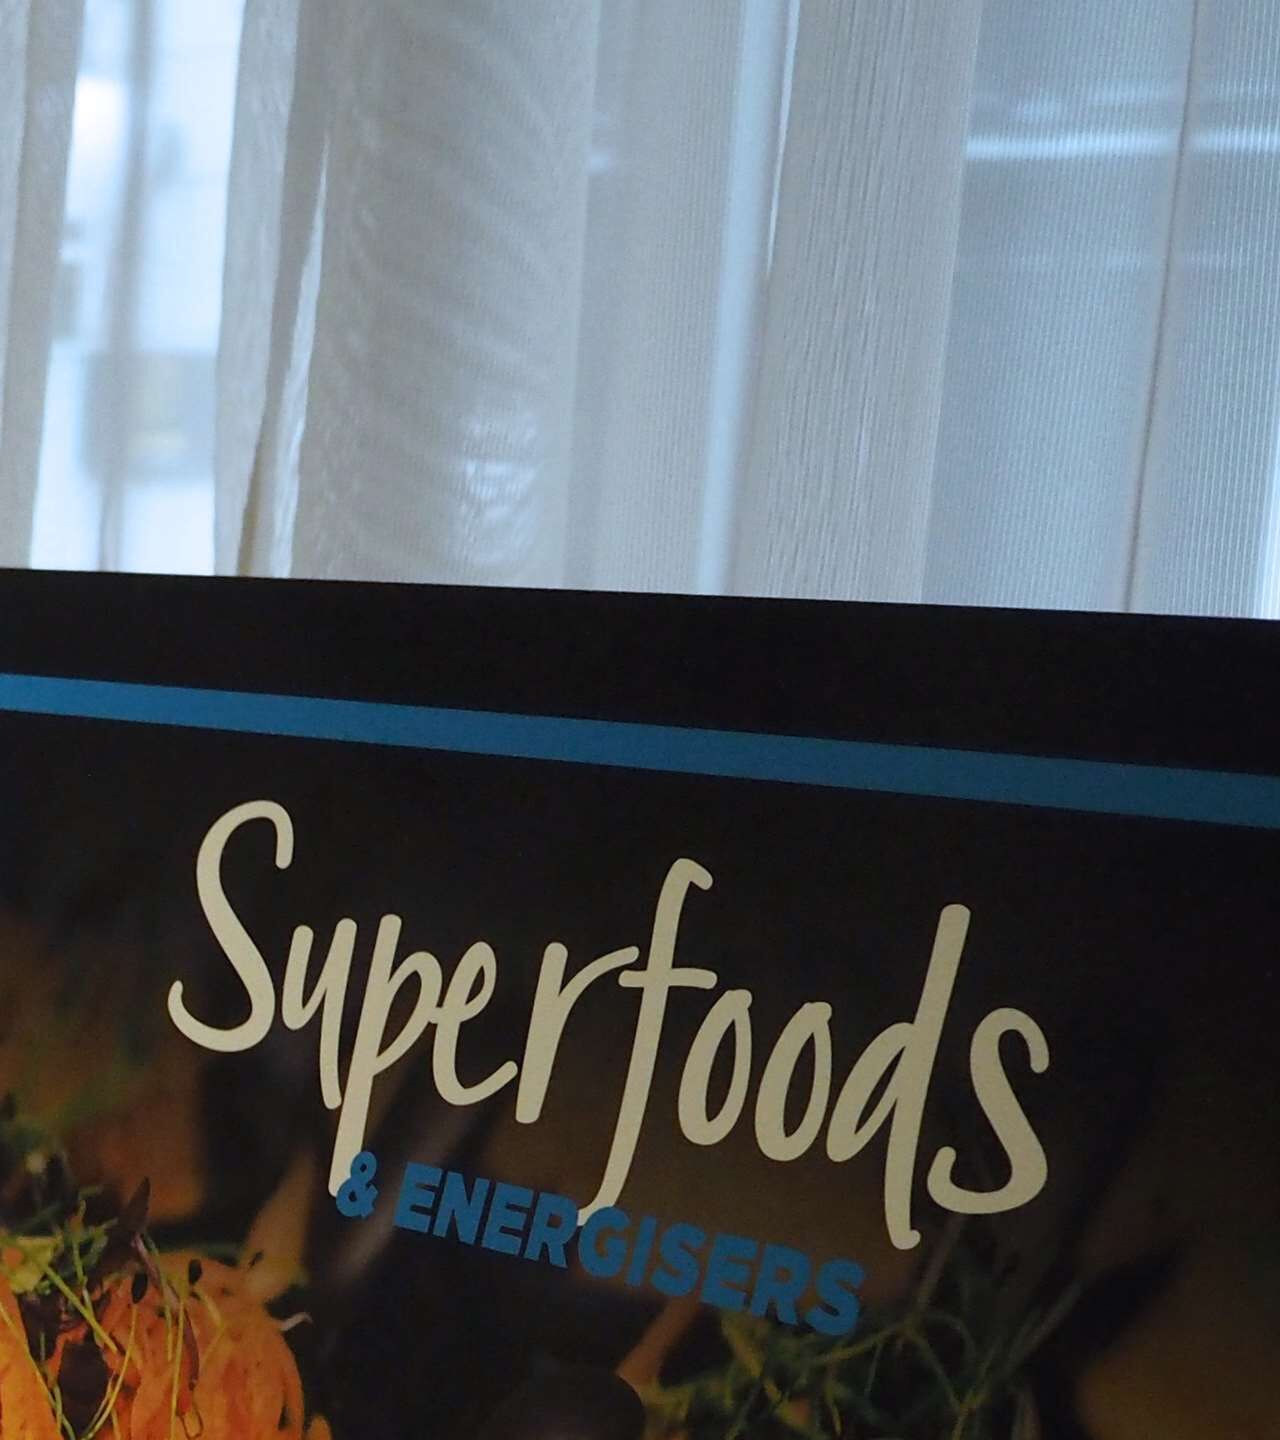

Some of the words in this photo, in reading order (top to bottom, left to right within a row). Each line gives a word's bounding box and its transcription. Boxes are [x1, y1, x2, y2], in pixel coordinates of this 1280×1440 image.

[167, 800, 1050, 1250] Superfoods
[336, 1150, 379, 1218] &
[392, 1162, 867, 1336] ENERGISERS
